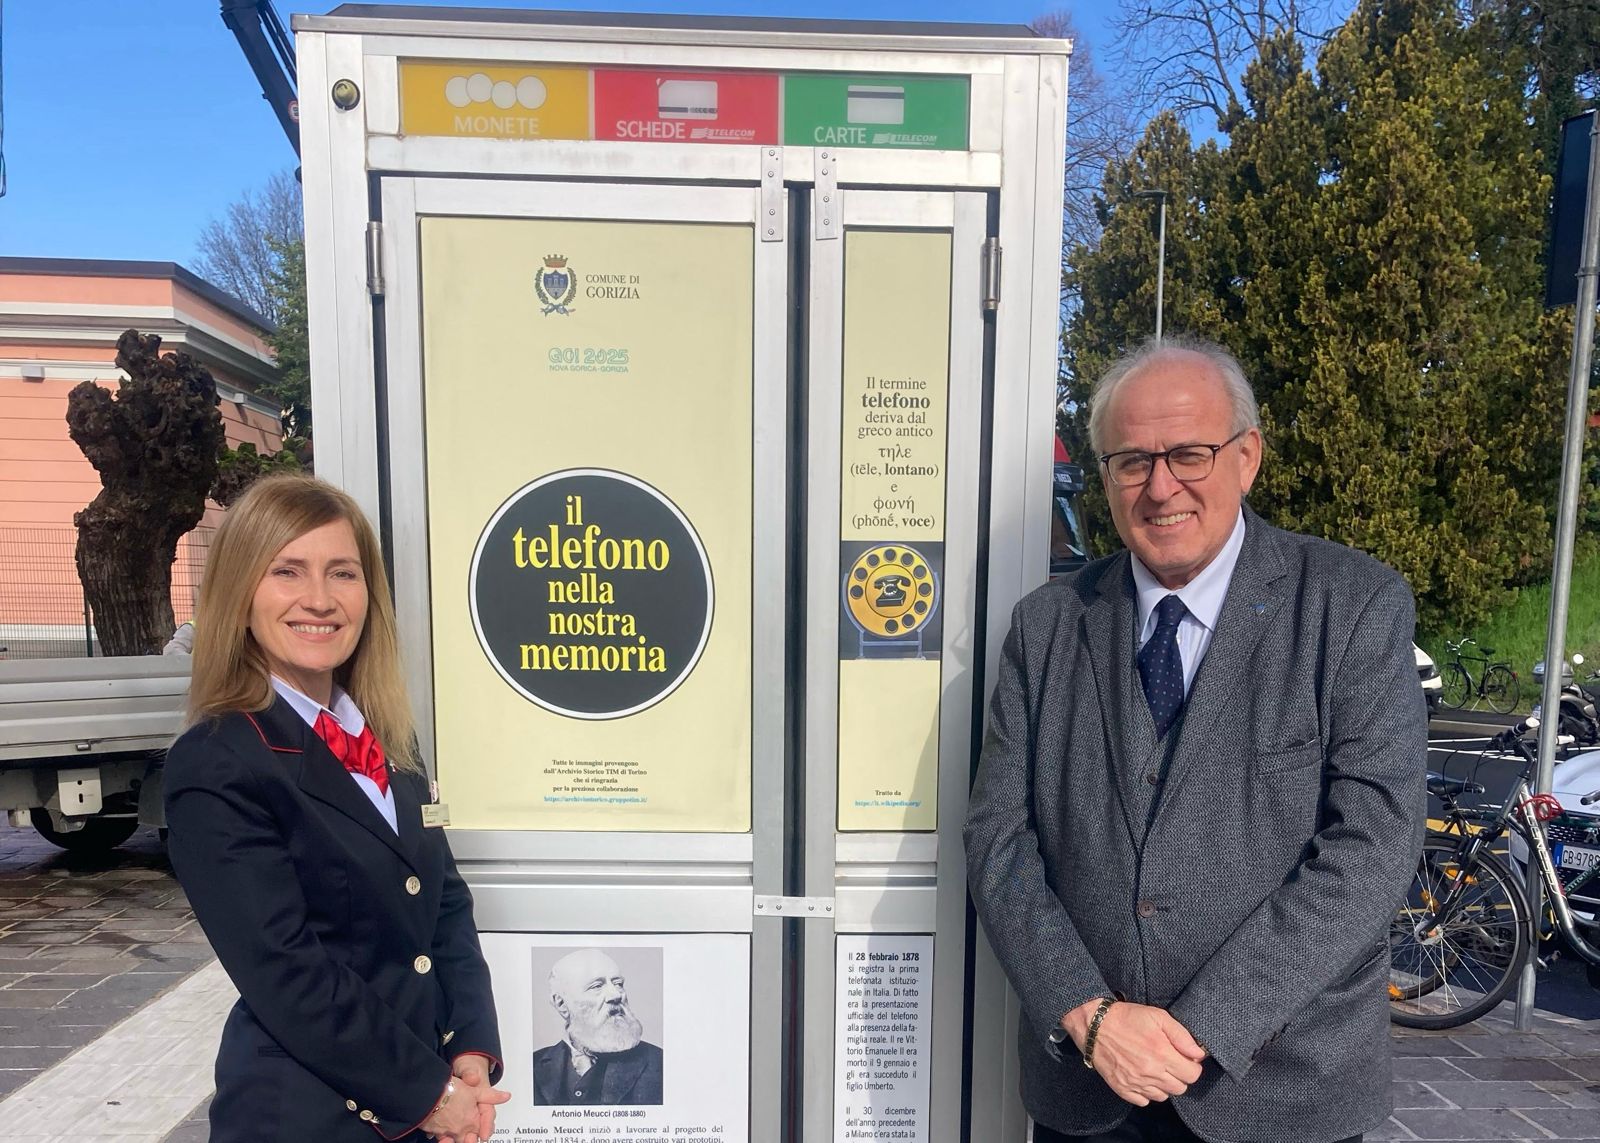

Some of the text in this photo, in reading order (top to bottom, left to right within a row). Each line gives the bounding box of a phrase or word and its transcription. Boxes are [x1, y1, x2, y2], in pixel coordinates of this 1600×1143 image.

[454, 115, 541, 135] MONETE
[616, 120, 686, 139] SCHEDE
[715, 128, 756, 138] TELECOM
[814, 126, 867, 144] CARTE
[897, 134, 938, 143] TELECOM
[586, 274, 640, 285] COMUNE DI
[586, 286, 640, 299] GORIZIA
[584, 348, 630, 365] 2025
[549, 364, 569, 373] NOVA
[867, 376, 927, 390] Il termine
[862, 392, 931, 409] telefono
[865, 411, 926, 424] deriva dal
[858, 425, 933, 439] greco antico
[878, 443, 912, 462] τηλε
[885, 464, 939, 478] lontano)
[890, 483, 898, 492] e
[566, 495, 583, 526] il
[902, 515, 936, 529] voce)
[513, 524, 670, 571] telefono
[548, 573, 615, 604] nella
[549, 608, 637, 636] nostra
[520, 635, 667, 673] memoria
[604, 760, 639, 768] provengono
[848, 952, 920, 961] Il 28 febbraio 1878
[848, 964, 919, 974] si registra la prima
[848, 976, 919, 985] telefonata istituzio-
[847, 988, 862, 996] nale
[873, 987, 891, 996] Italia.
[893, 988, 901, 997] Di
[903, 988, 919, 997] fatto
[862, 1000, 868, 1008] la
[871, 1000, 919, 1010] presentazione
[847, 1011, 918, 1020] ufficiale del telefono
[847, 1023, 859, 1031] alla
[860, 1024, 890, 1033] presenza
[891, 1023, 907, 1032] della
[847, 1035, 868, 1045] miglia
[869, 1035, 888, 1044] reale.
[905, 1035, 918, 1044] Vit-
[847, 1046, 863, 1055] torio
[865, 1046, 898, 1055] Emanuele
[847, 1059, 867, 1067] morto
[869, 1059, 874, 1067] il
[876, 1058, 881, 1067] 9
[884, 1058, 911, 1068] gennaio
[846, 1070, 855, 1080] gli
[874, 1070, 909, 1079] succeduto
[912, 1070, 917, 1079] il
[846, 1081, 895, 1092] figlio Umberto.
[552, 1109, 582, 1118] Antonio
[584, 1109, 611, 1118] Meucci
[846, 1106, 916, 1115] Il 30 dicembre
[846, 1118, 916, 1128] dell'anno precedente
[515, 1126, 548, 1134] Antonio
[553, 1126, 583, 1134] Meucci
[589, 1125, 611, 1134] iniziò
[626, 1125, 658, 1134] lavorare
[662, 1125, 670, 1133] al
[675, 1126, 707, 1135] progetto
[711, 1125, 724, 1133] del
[851, 1129, 873, 1138] Milano
[874, 1129, 890, 1138] c'era
[891, 1130, 908, 1138] stata
[909, 1129, 916, 1138] la
